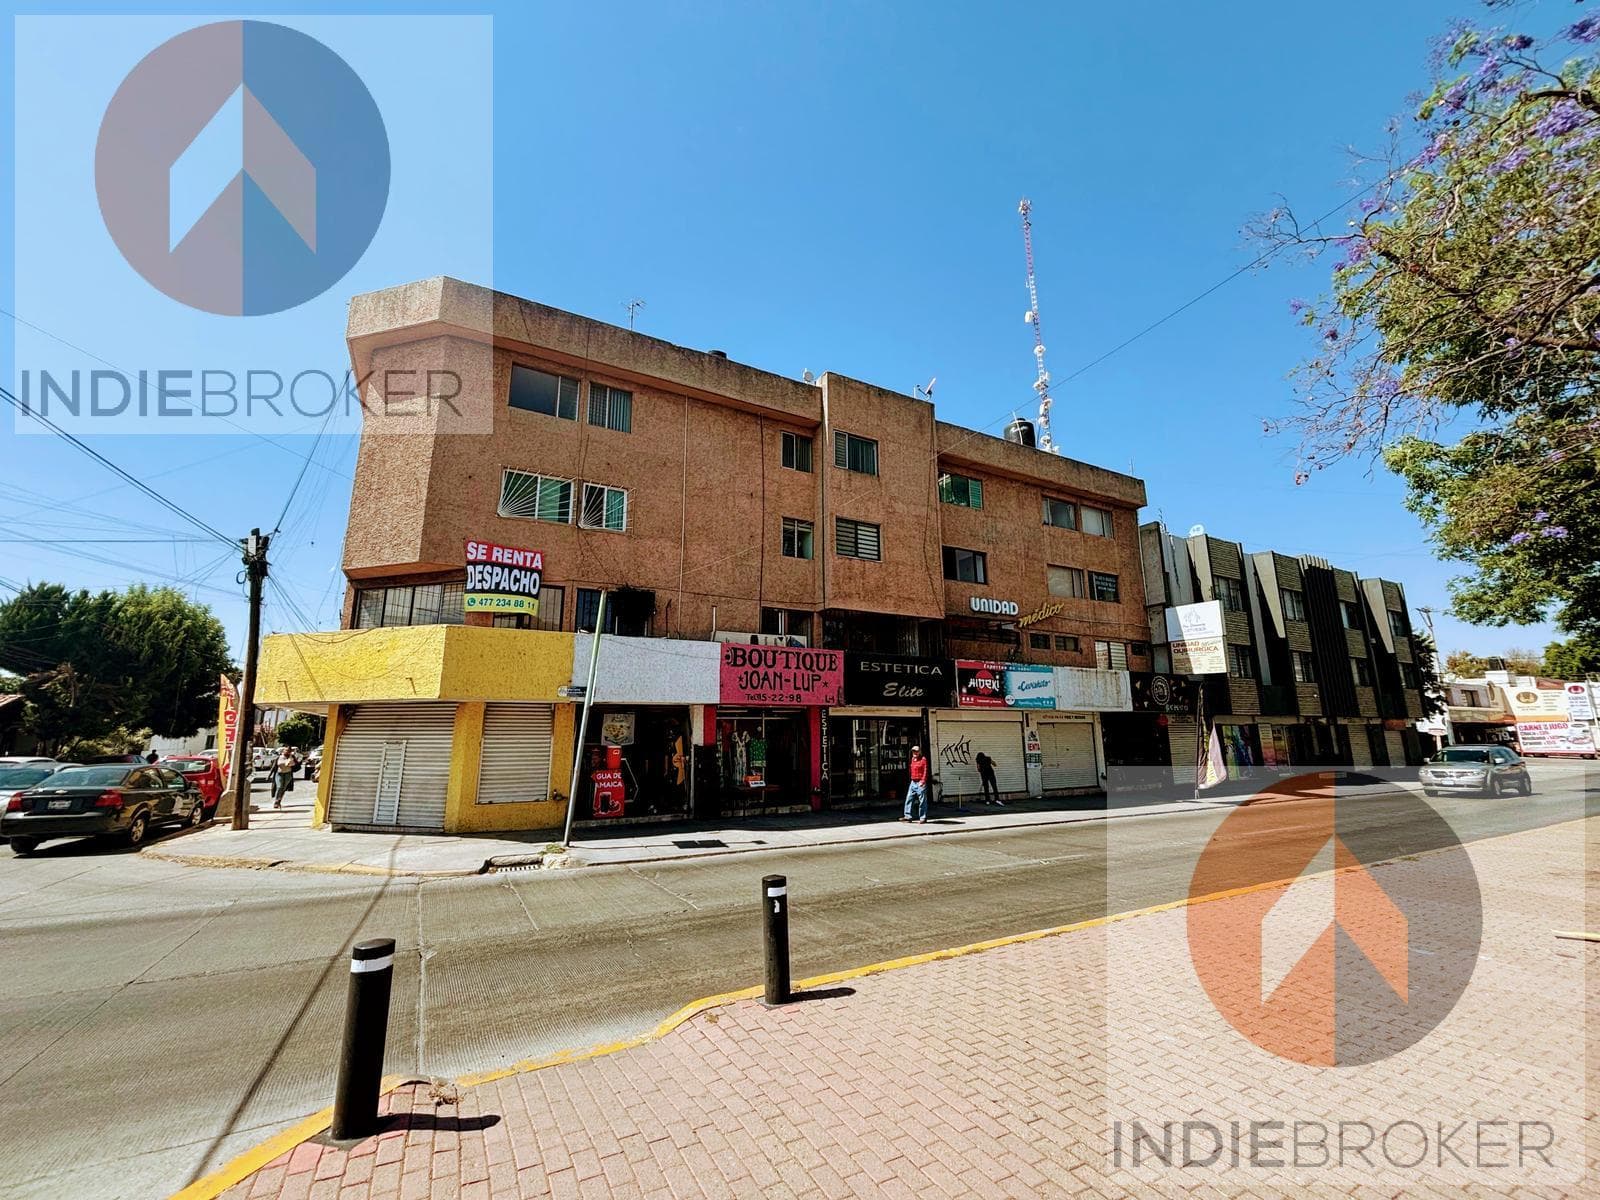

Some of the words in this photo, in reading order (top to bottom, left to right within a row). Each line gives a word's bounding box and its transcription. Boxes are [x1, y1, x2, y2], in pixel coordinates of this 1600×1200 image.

[466, 541, 487, 560] SE
[491, 546, 542, 569] RENTA
[466, 564, 540, 595] DESPACHO
[478, 598, 494, 606] 477
[513, 599, 524, 607] 88
[970, 597, 1019, 615] UNIDAD
[730, 647, 838, 672] BOUTIQUE
[860, 661, 942, 675] ESTETICA
[883, 682, 923, 697] Elite
[821, 709, 829, 780] ESTETICA
